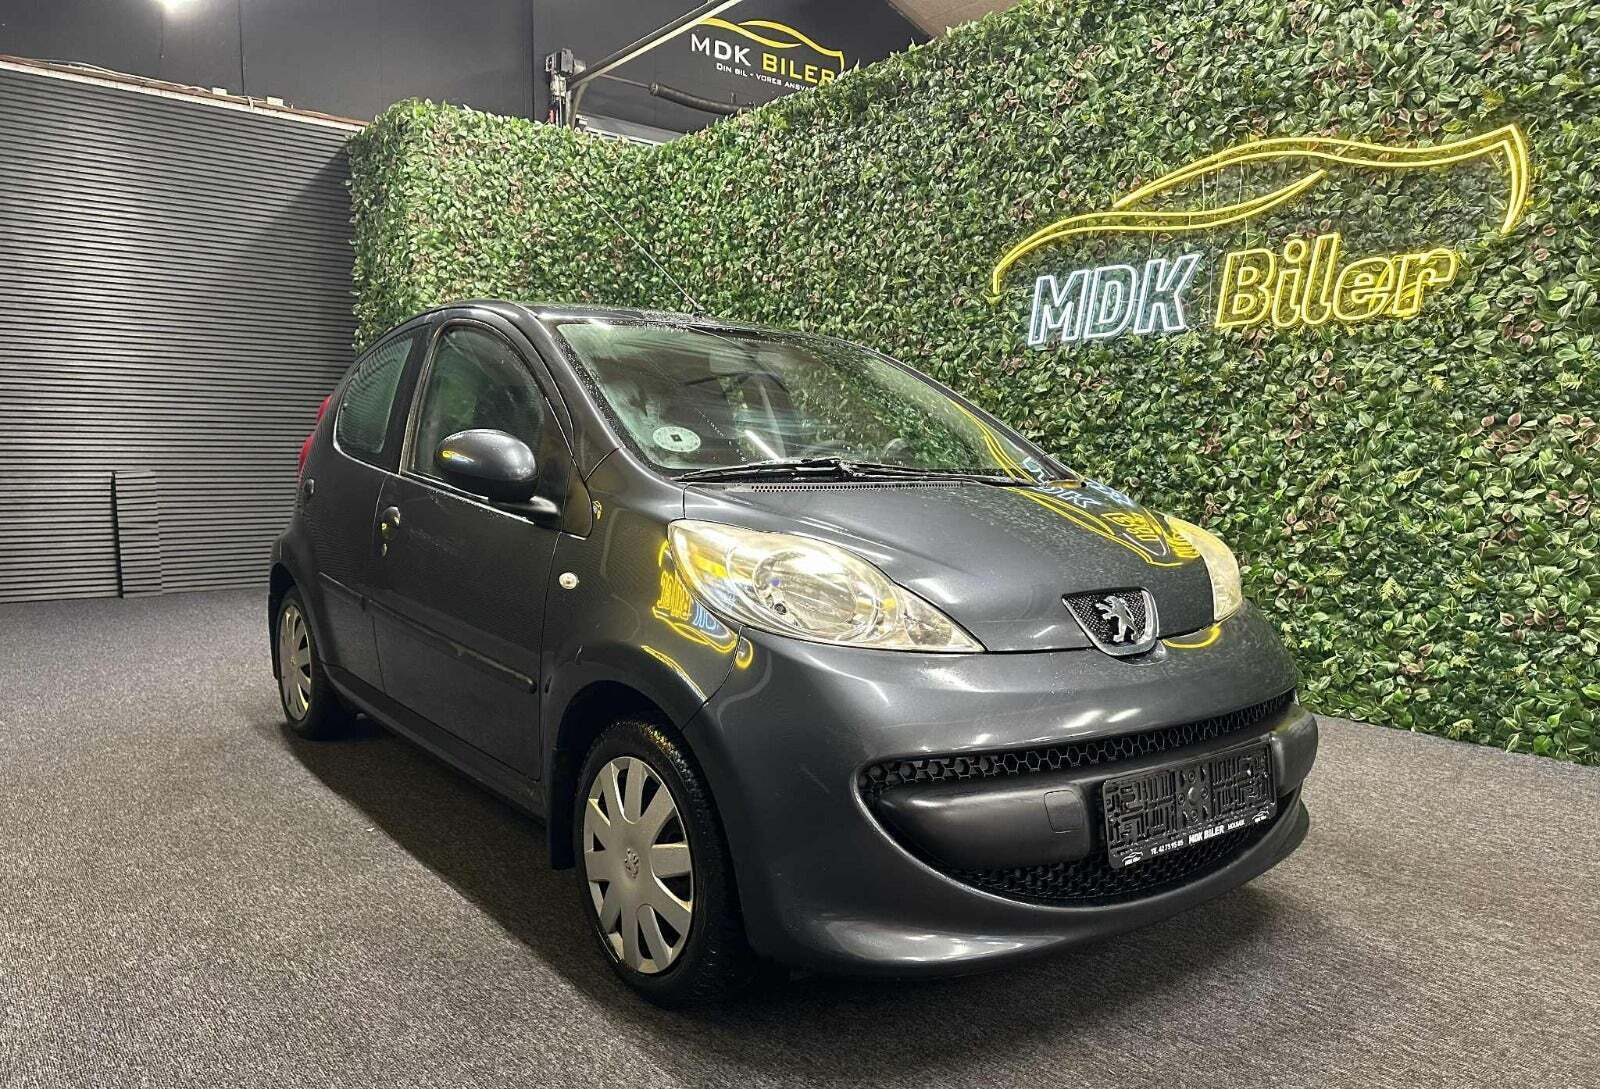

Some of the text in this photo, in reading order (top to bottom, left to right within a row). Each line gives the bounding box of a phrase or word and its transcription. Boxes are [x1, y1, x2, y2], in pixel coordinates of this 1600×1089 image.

[691, 33, 835, 84] MDK BILER
[1028, 232, 1458, 346] MDK Biler
[1203, 825, 1226, 840] BILER
